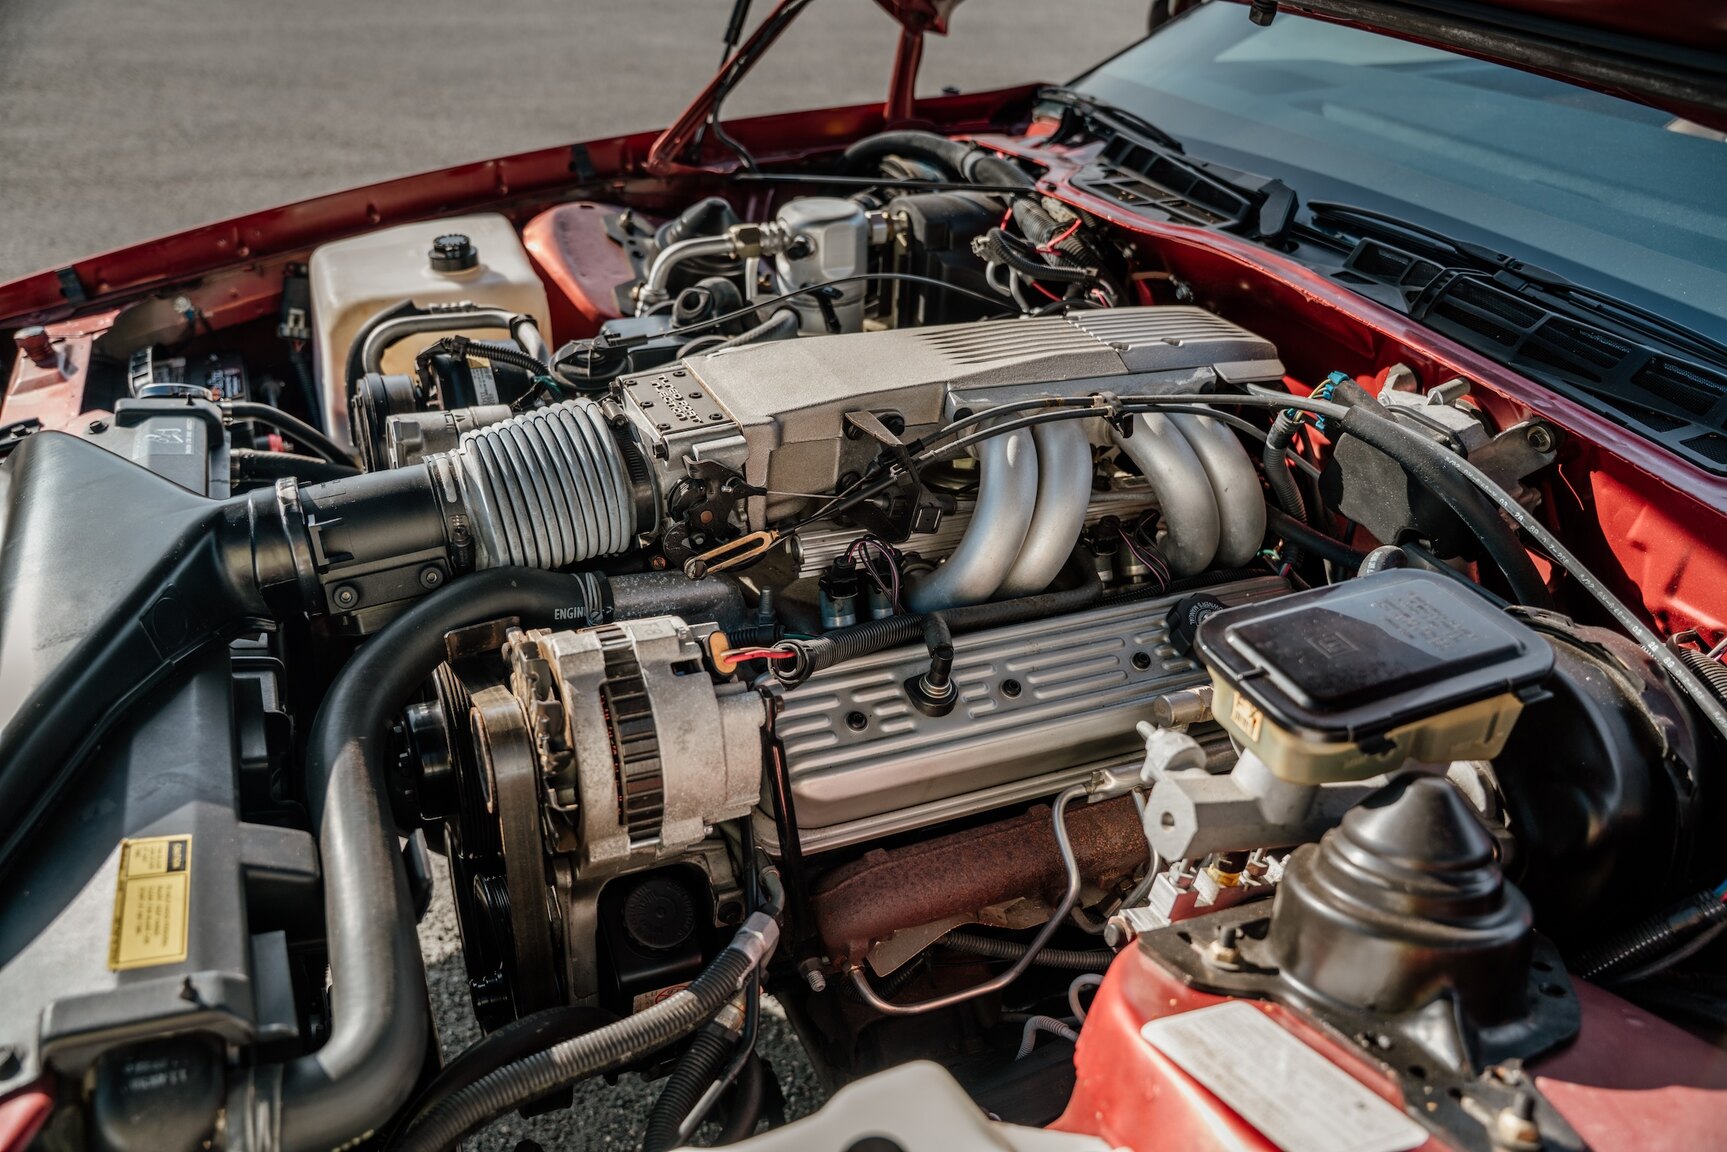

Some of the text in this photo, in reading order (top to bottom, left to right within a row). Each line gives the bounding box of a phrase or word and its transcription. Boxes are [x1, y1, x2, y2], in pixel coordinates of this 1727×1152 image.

[652, 380, 688, 421] INJECTION
[659, 374, 703, 423] TUNED PORT
